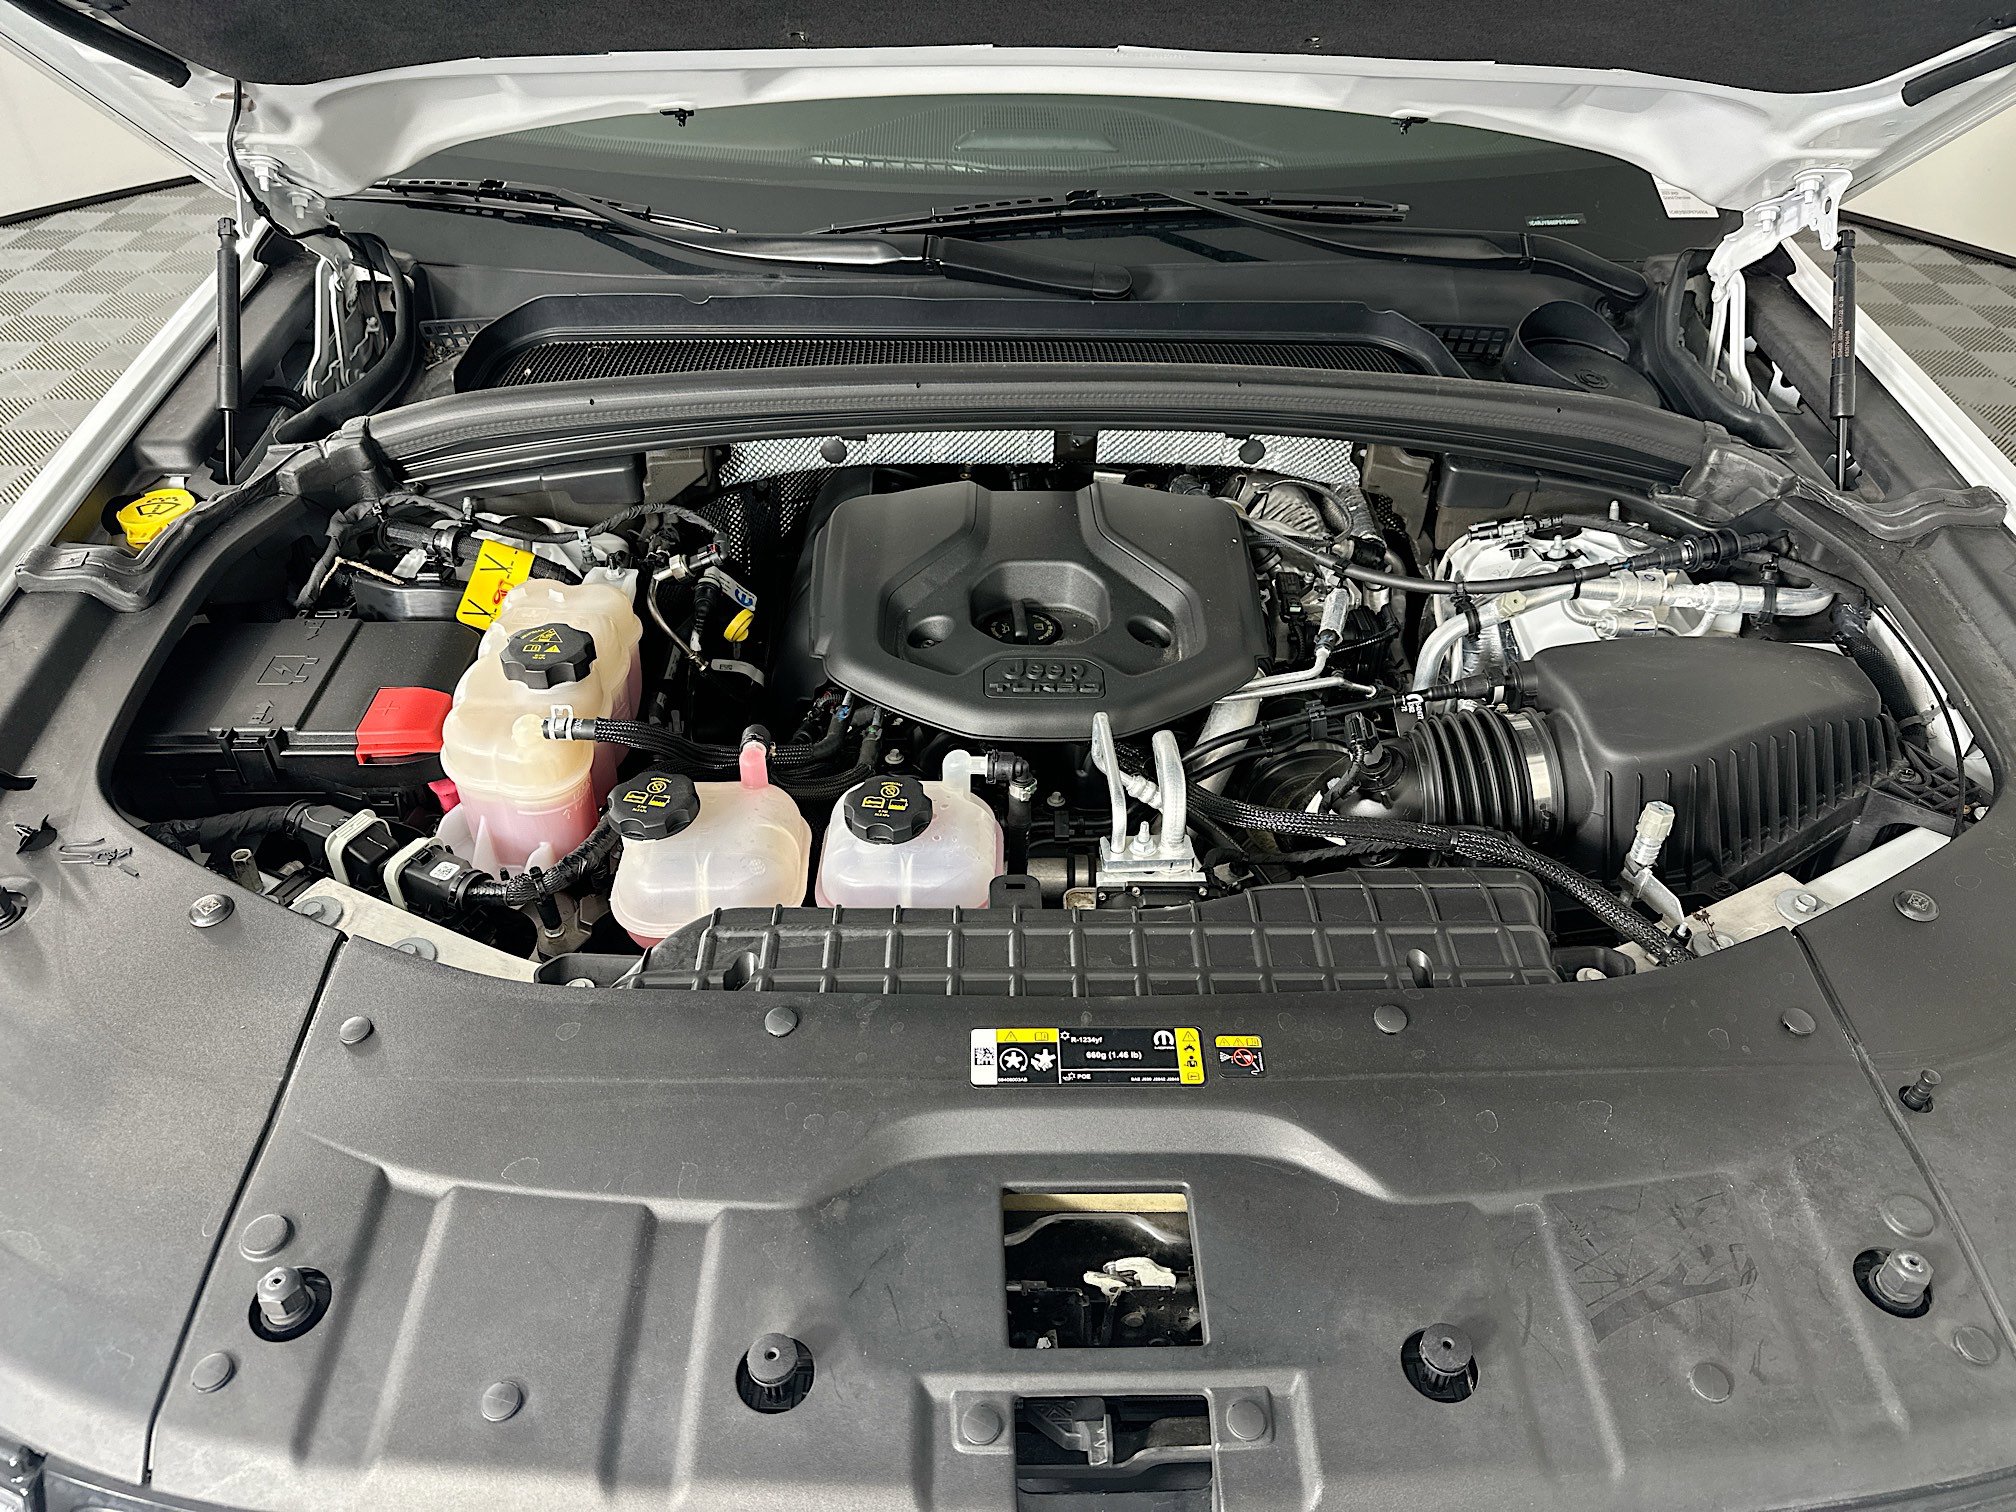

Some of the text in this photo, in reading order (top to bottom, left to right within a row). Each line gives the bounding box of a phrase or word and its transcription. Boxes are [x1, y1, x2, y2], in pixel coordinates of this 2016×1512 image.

[1002, 660, 1085, 682] Jeep
[1070, 1036, 1103, 1044] R-1234yf
[1130, 1051, 1143, 1060] lb)
